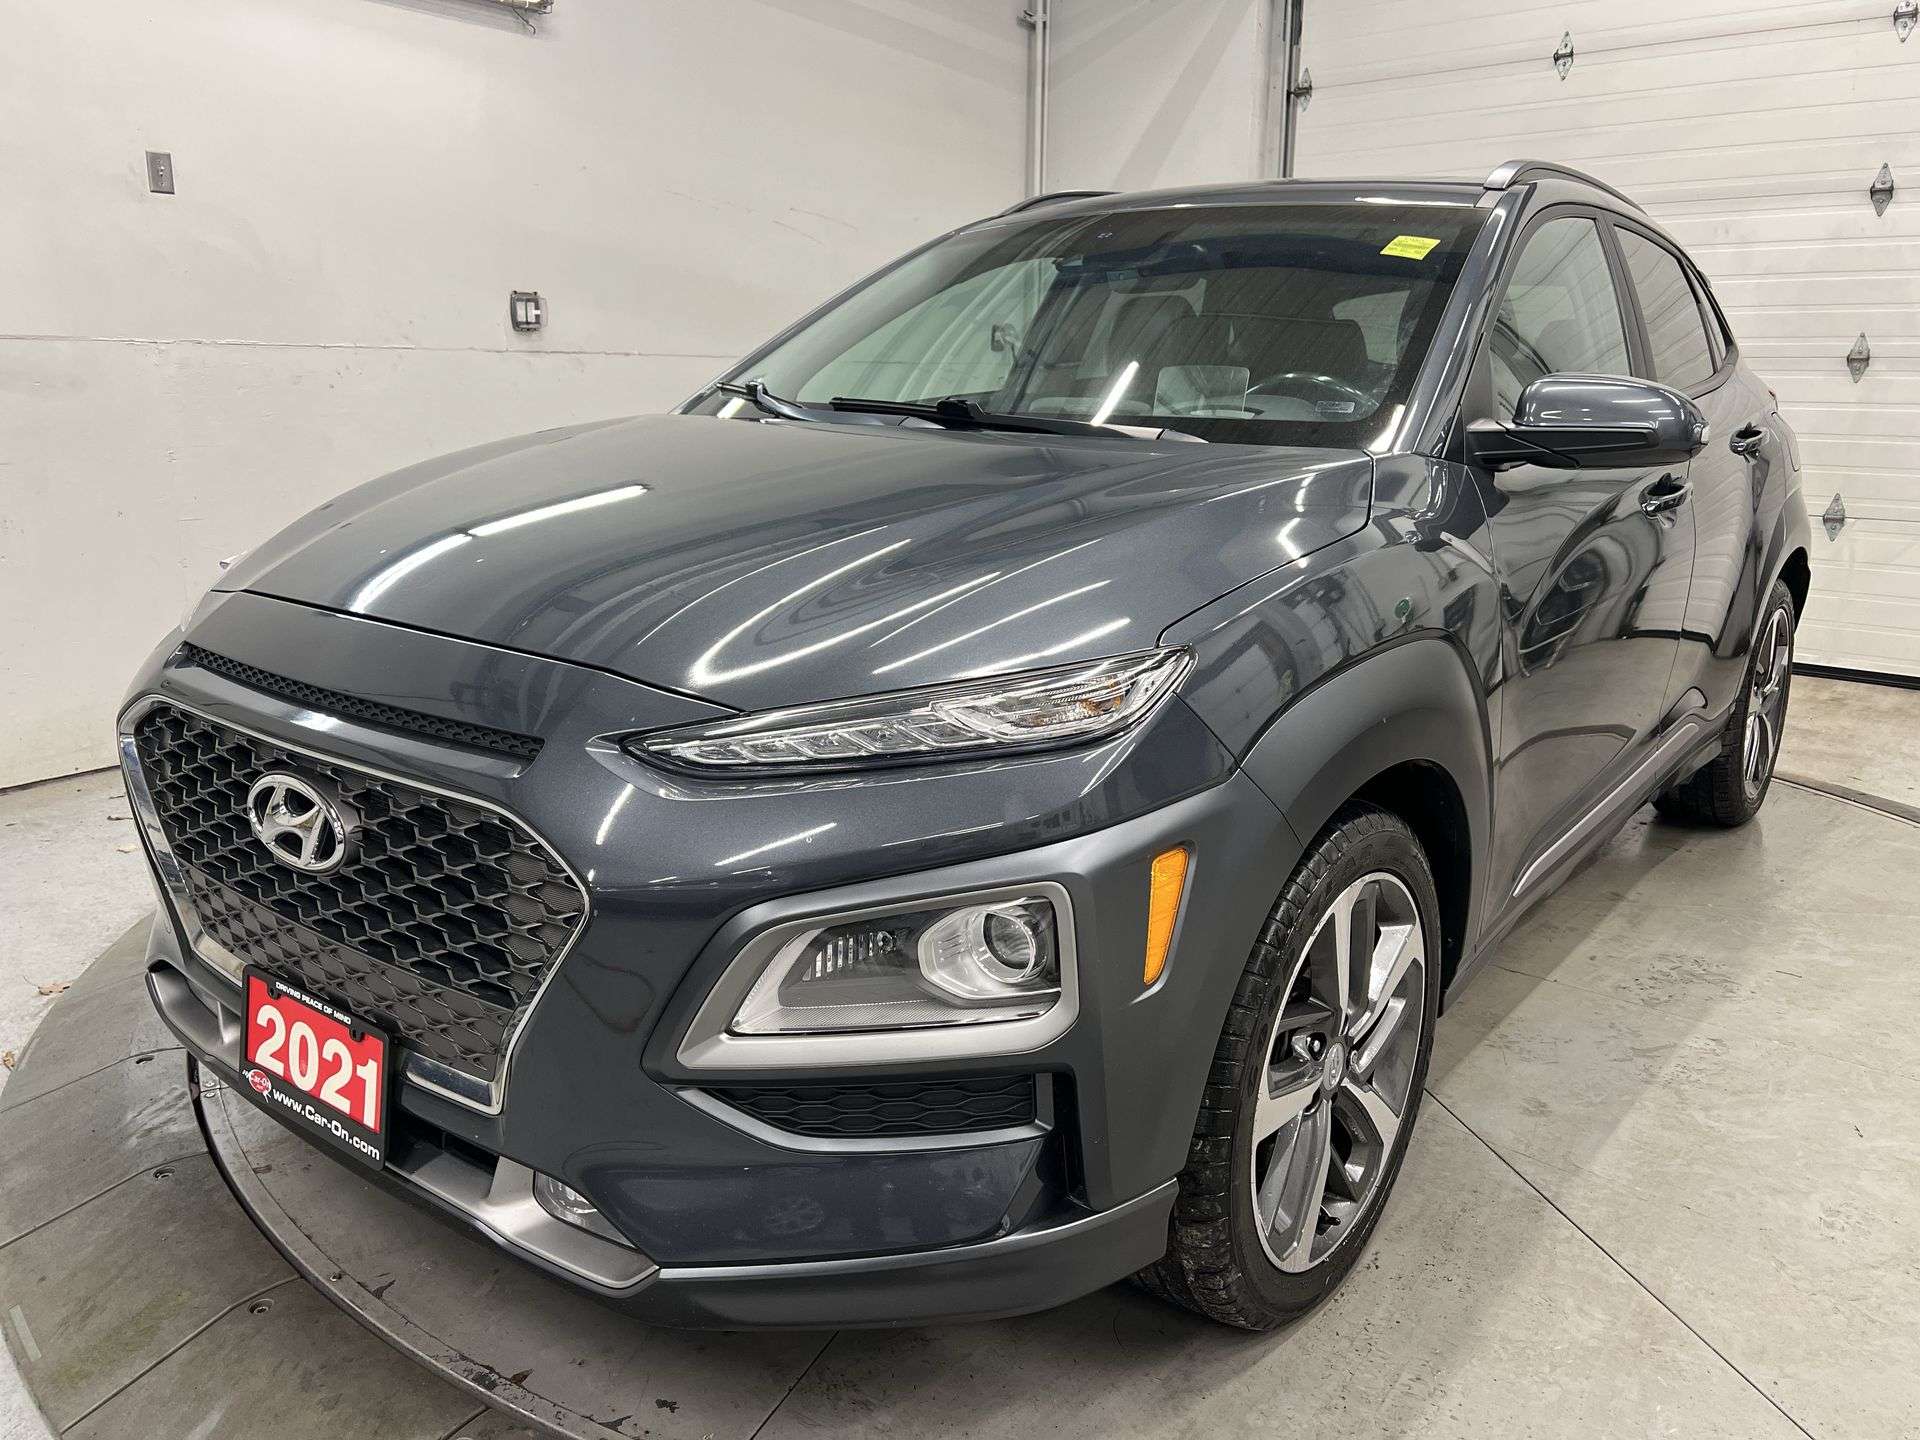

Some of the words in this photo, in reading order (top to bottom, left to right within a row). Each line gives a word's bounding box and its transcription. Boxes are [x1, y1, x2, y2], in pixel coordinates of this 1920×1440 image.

[275, 981, 301, 1000] DRIVING
[301, 994, 323, 1011] PEACE
[323, 1005, 333, 1015] OF
[333, 1010, 352, 1025] MIND
[255, 1004, 378, 1129] 2021
[273, 1088, 380, 1161] www.Car-On.com
